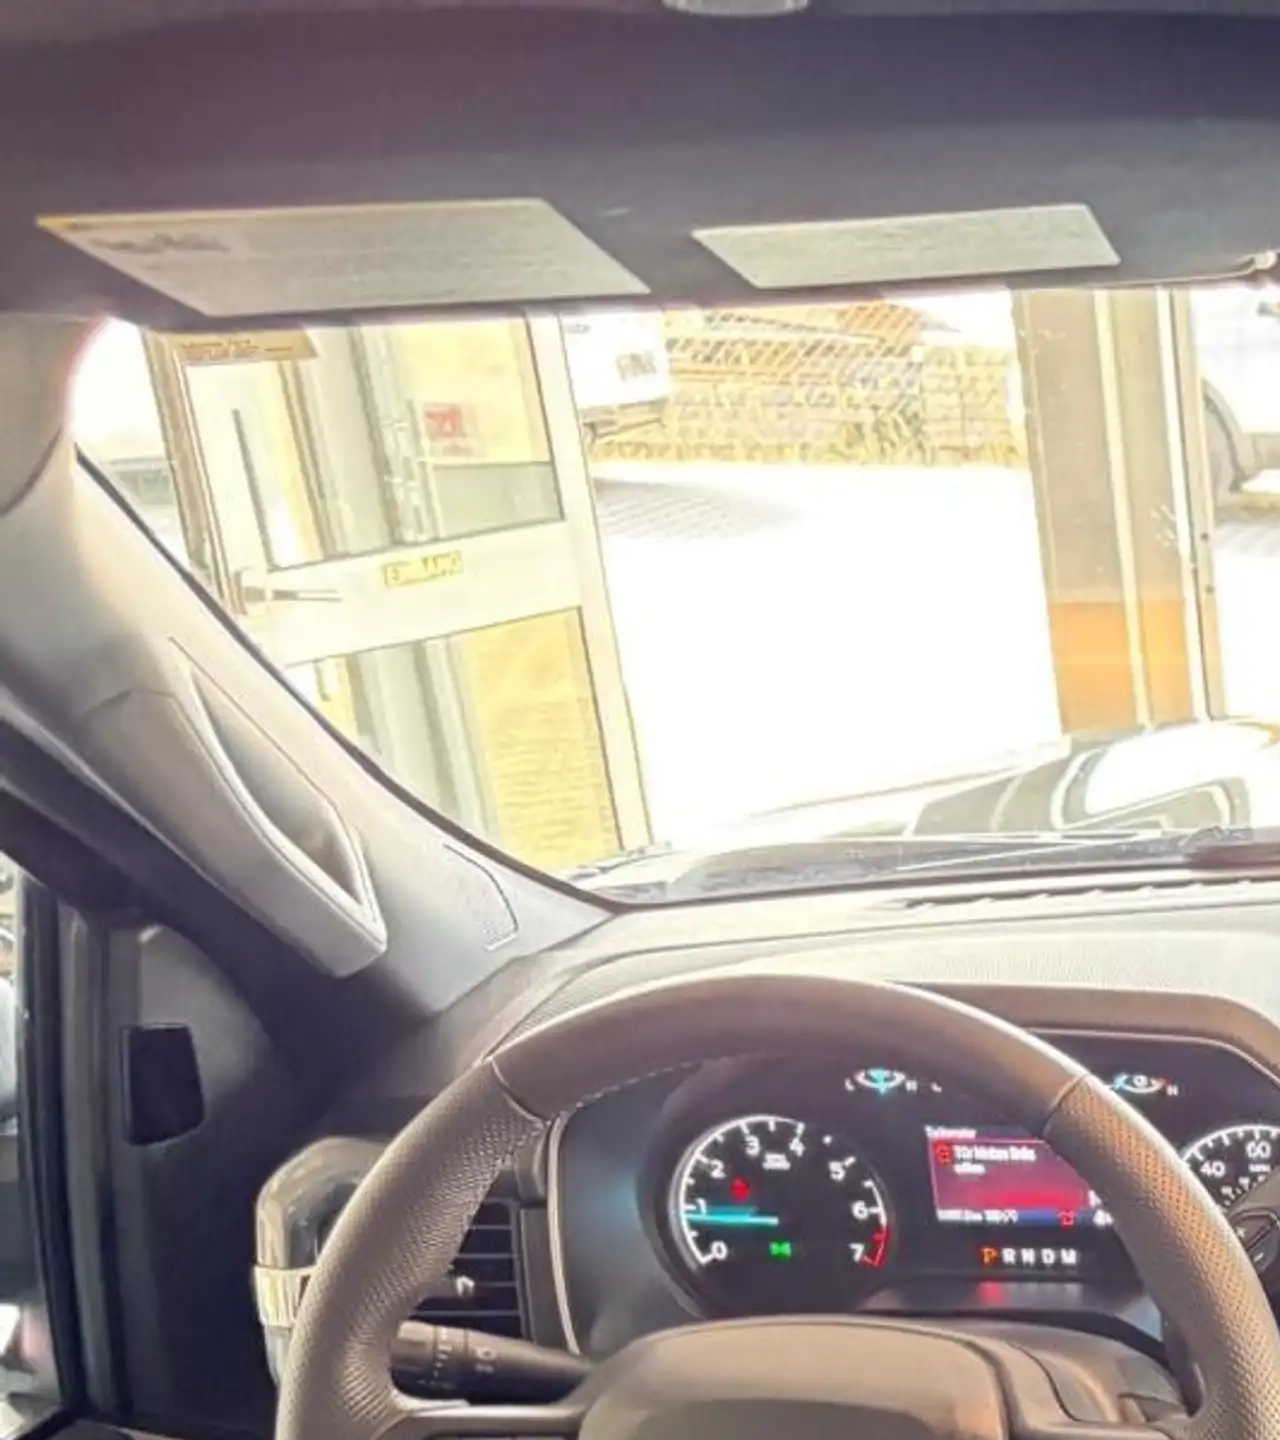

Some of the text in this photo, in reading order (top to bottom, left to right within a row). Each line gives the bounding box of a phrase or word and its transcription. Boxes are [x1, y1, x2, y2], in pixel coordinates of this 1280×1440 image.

[746, 1136, 761, 1156] 3
[789, 1137, 805, 1156] 4
[1246, 1141, 1271, 1161] 60
[710, 1160, 726, 1178] 2
[829, 1161, 846, 1180] 5
[1200, 1161, 1225, 1177] 40
[853, 1201, 868, 1219] 6
[711, 1241, 727, 1259] 0
[849, 1243, 864, 1261] 7
[1002, 1249, 1015, 1263] R
[1022, 1249, 1035, 1264] N
[1042, 1249, 1054, 1263] D
[1061, 1249, 1076, 1263] M
